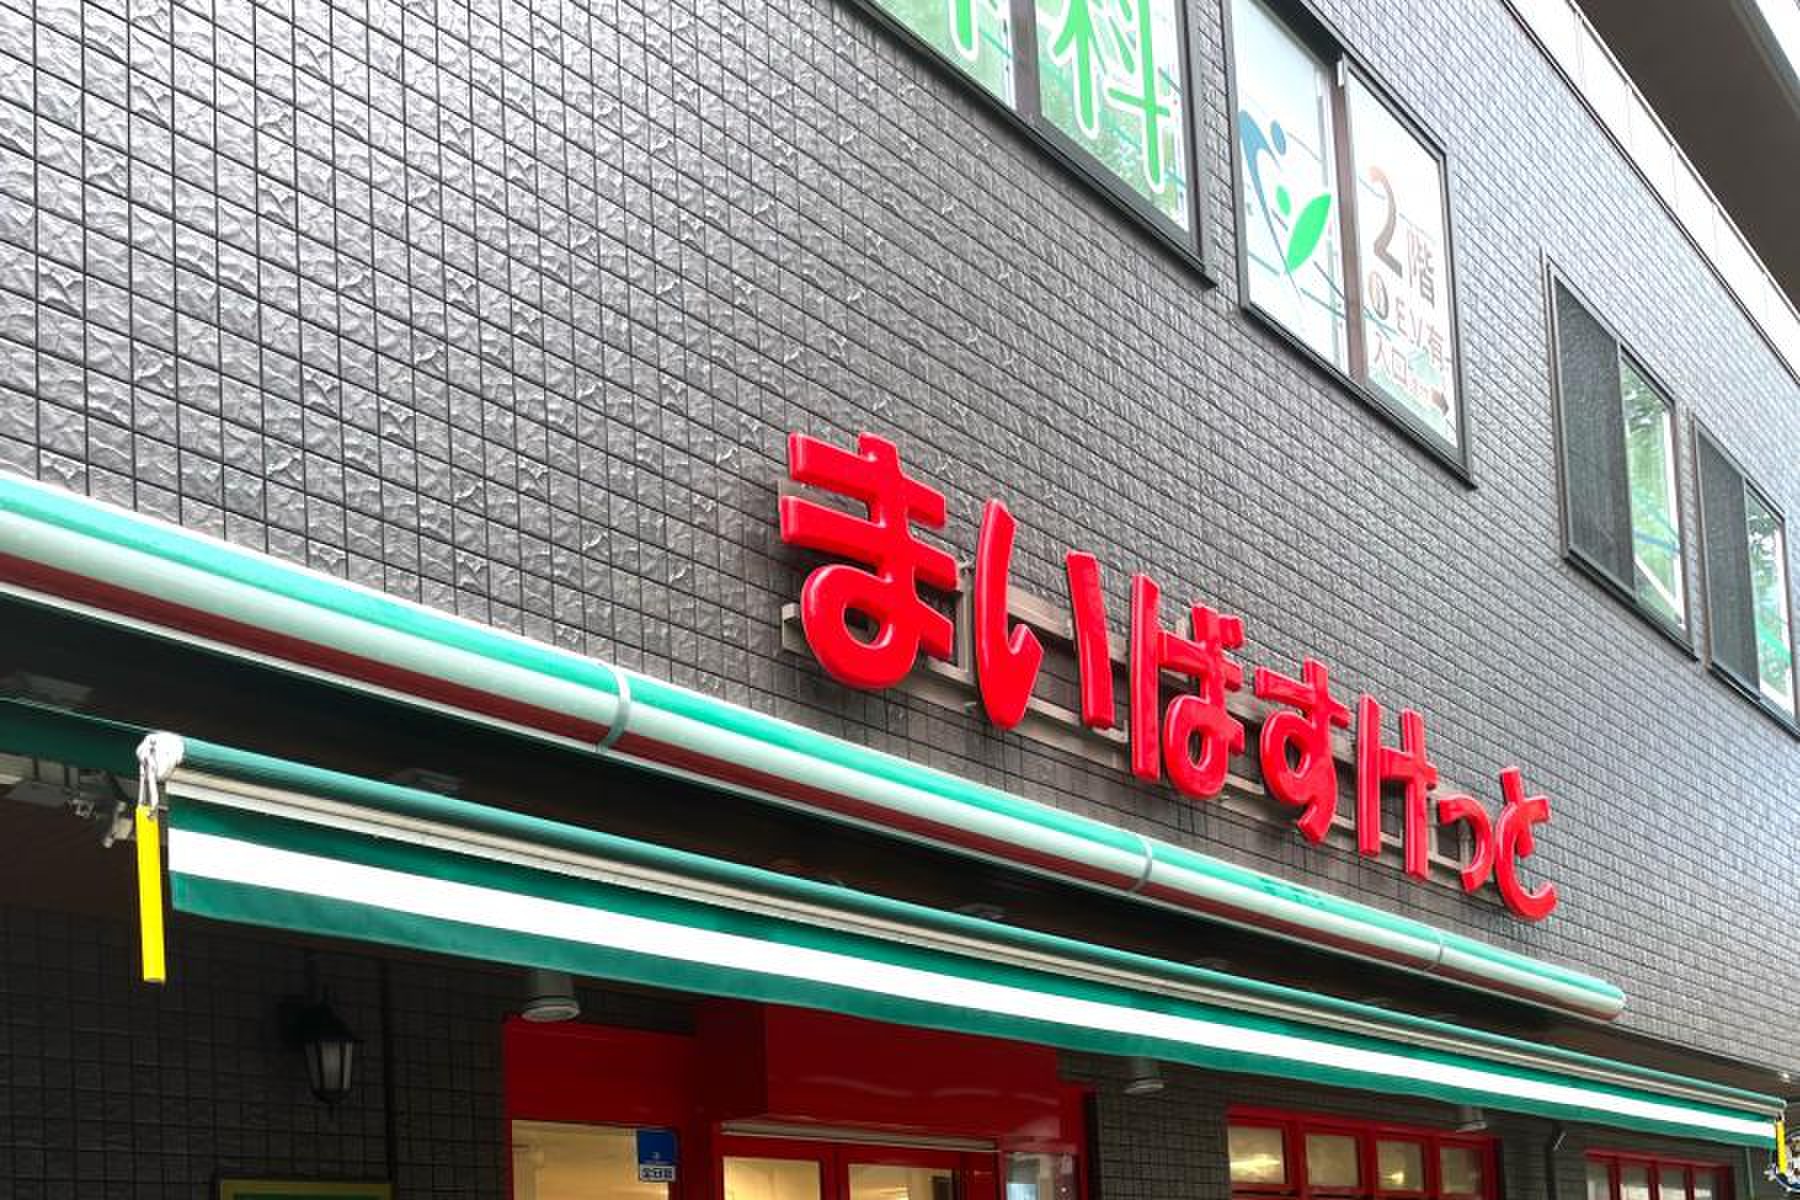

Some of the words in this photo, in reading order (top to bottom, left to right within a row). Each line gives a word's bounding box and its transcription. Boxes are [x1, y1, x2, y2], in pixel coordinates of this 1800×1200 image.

[780, 432, 1559, 921] まいばすけっと
